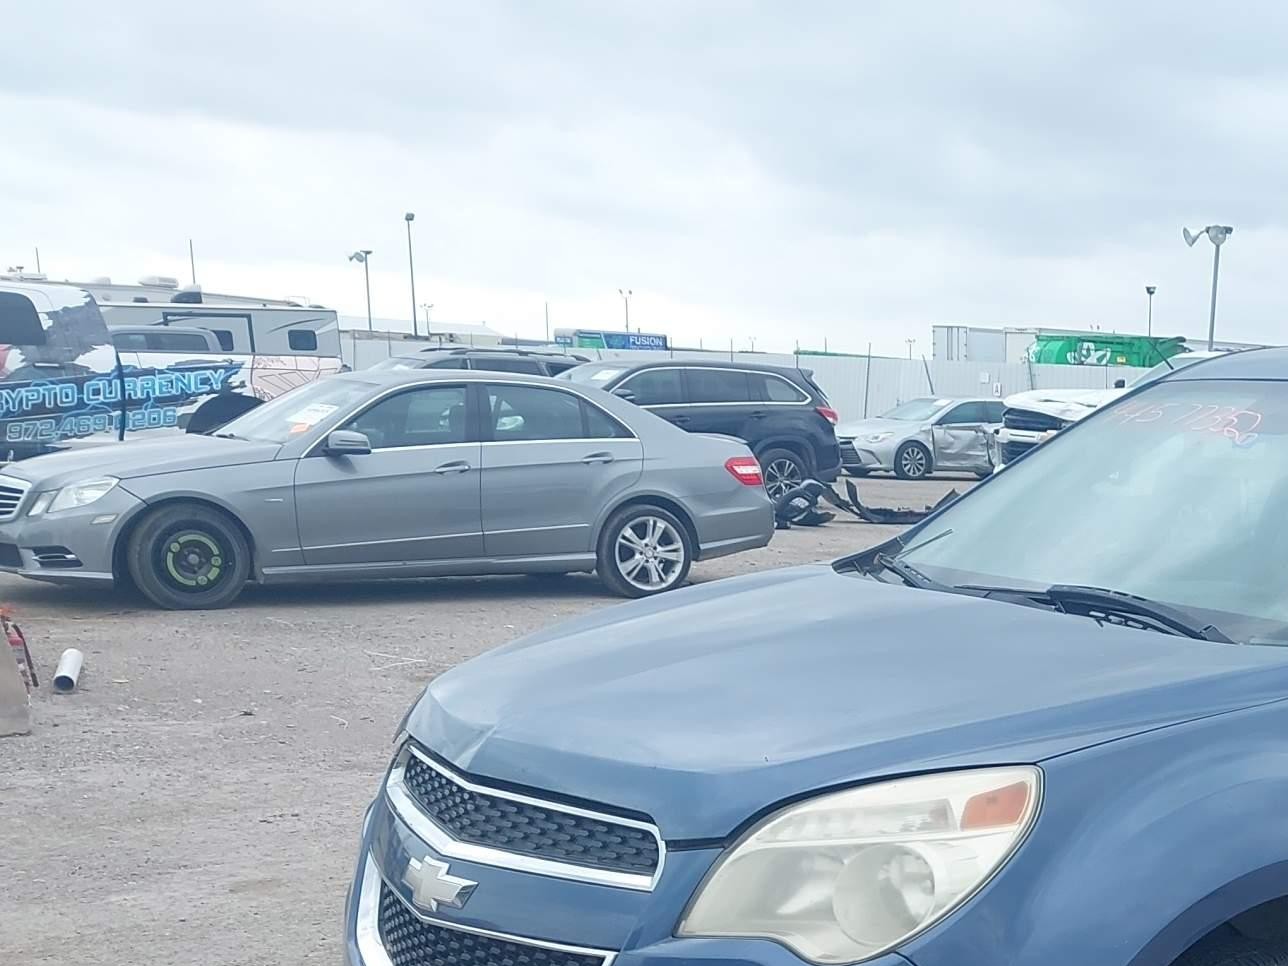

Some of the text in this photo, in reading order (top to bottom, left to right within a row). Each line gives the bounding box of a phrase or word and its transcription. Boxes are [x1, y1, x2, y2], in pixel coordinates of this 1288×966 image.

[629, 335, 664, 346] FUSION
[0, 369, 225, 411] YPTO CURRENCY
